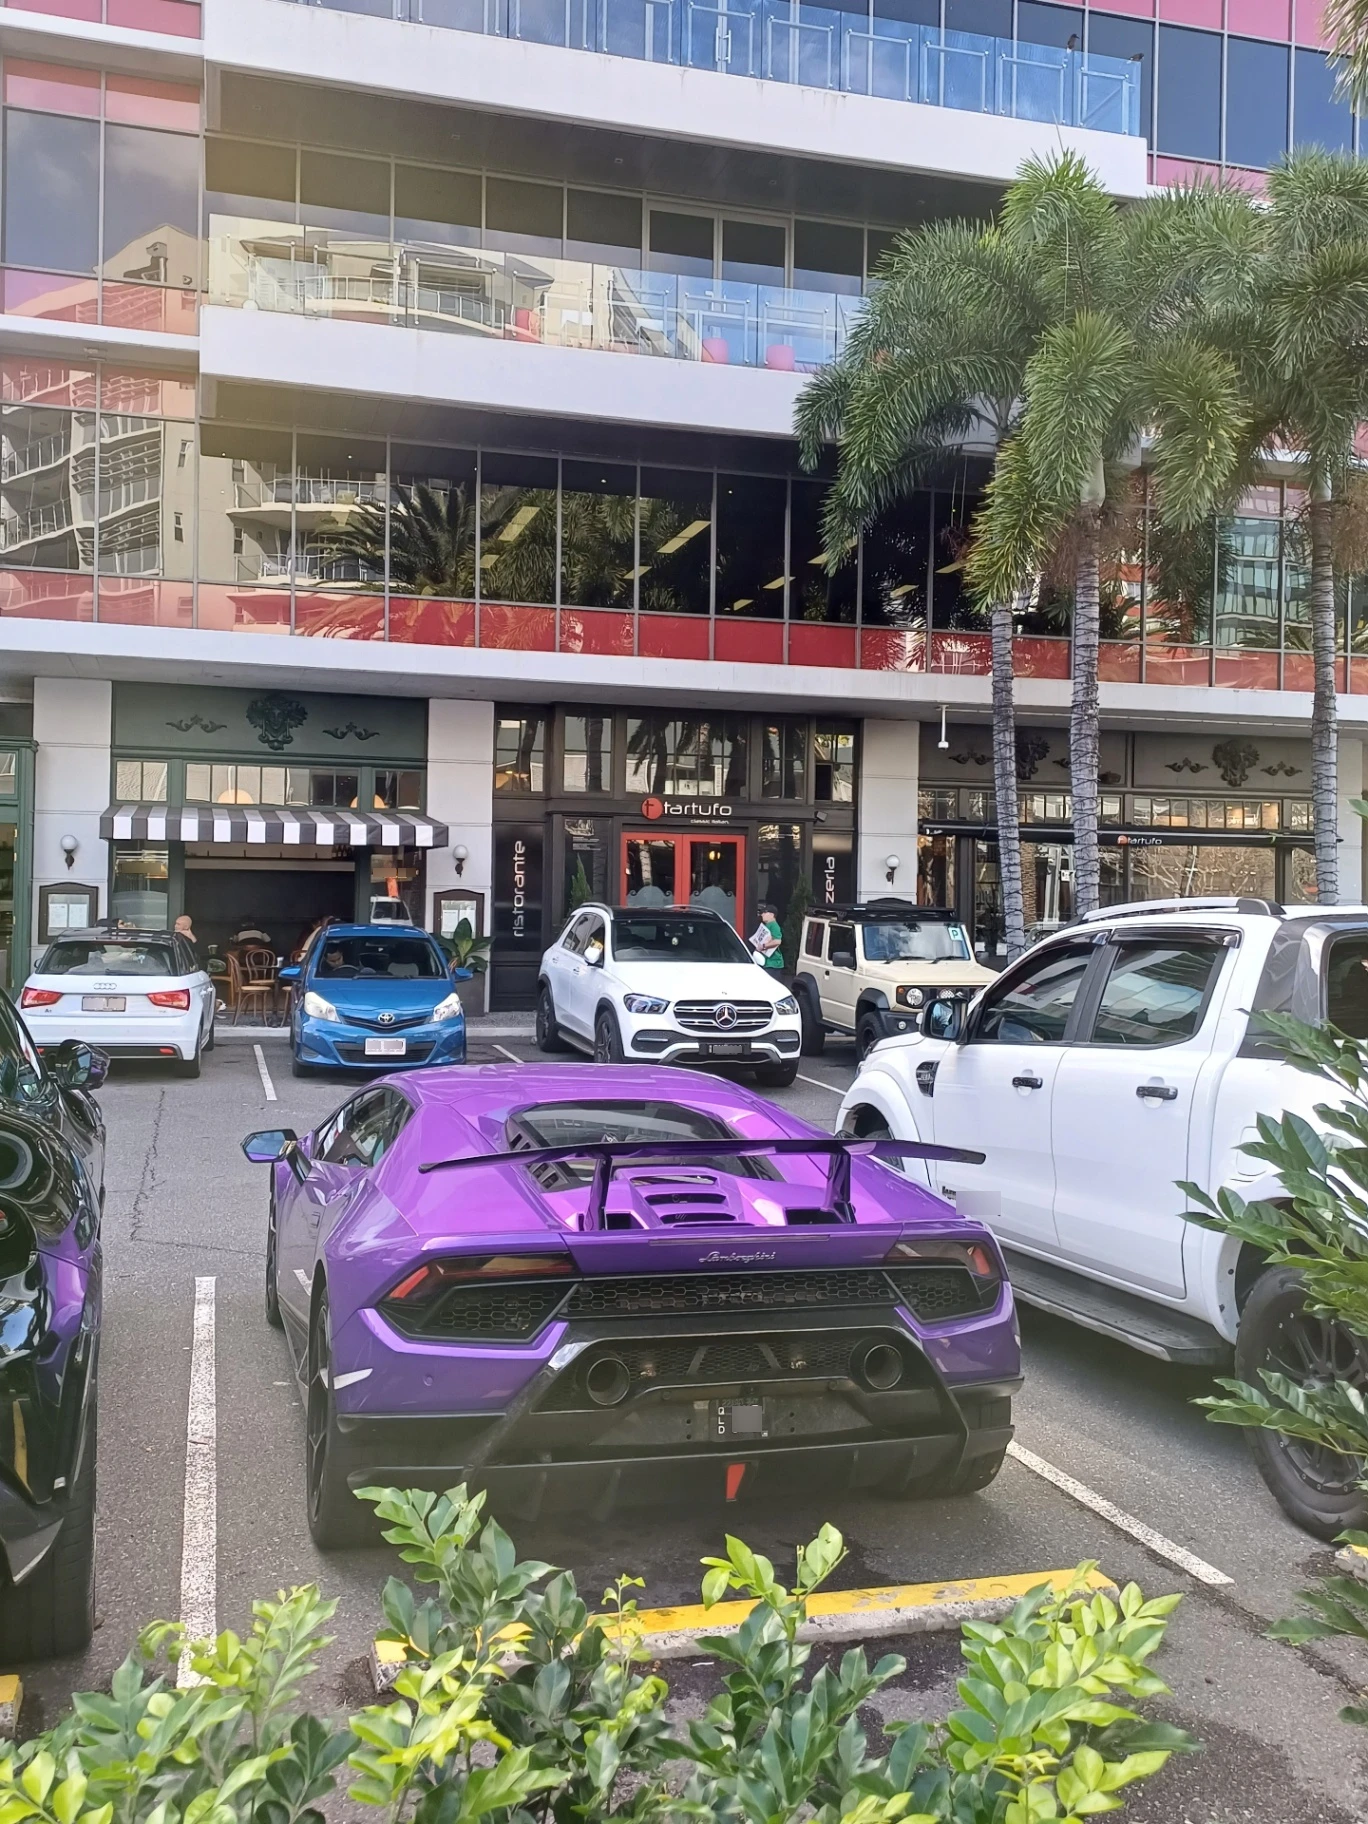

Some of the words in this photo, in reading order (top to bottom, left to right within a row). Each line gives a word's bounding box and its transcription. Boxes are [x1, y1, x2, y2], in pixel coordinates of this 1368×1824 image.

[664, 801, 732, 816] tartufo
[1127, 836, 1163, 845] tartufo
[512, 840, 526, 937] ristorante
[824, 856, 835, 904] zeria
